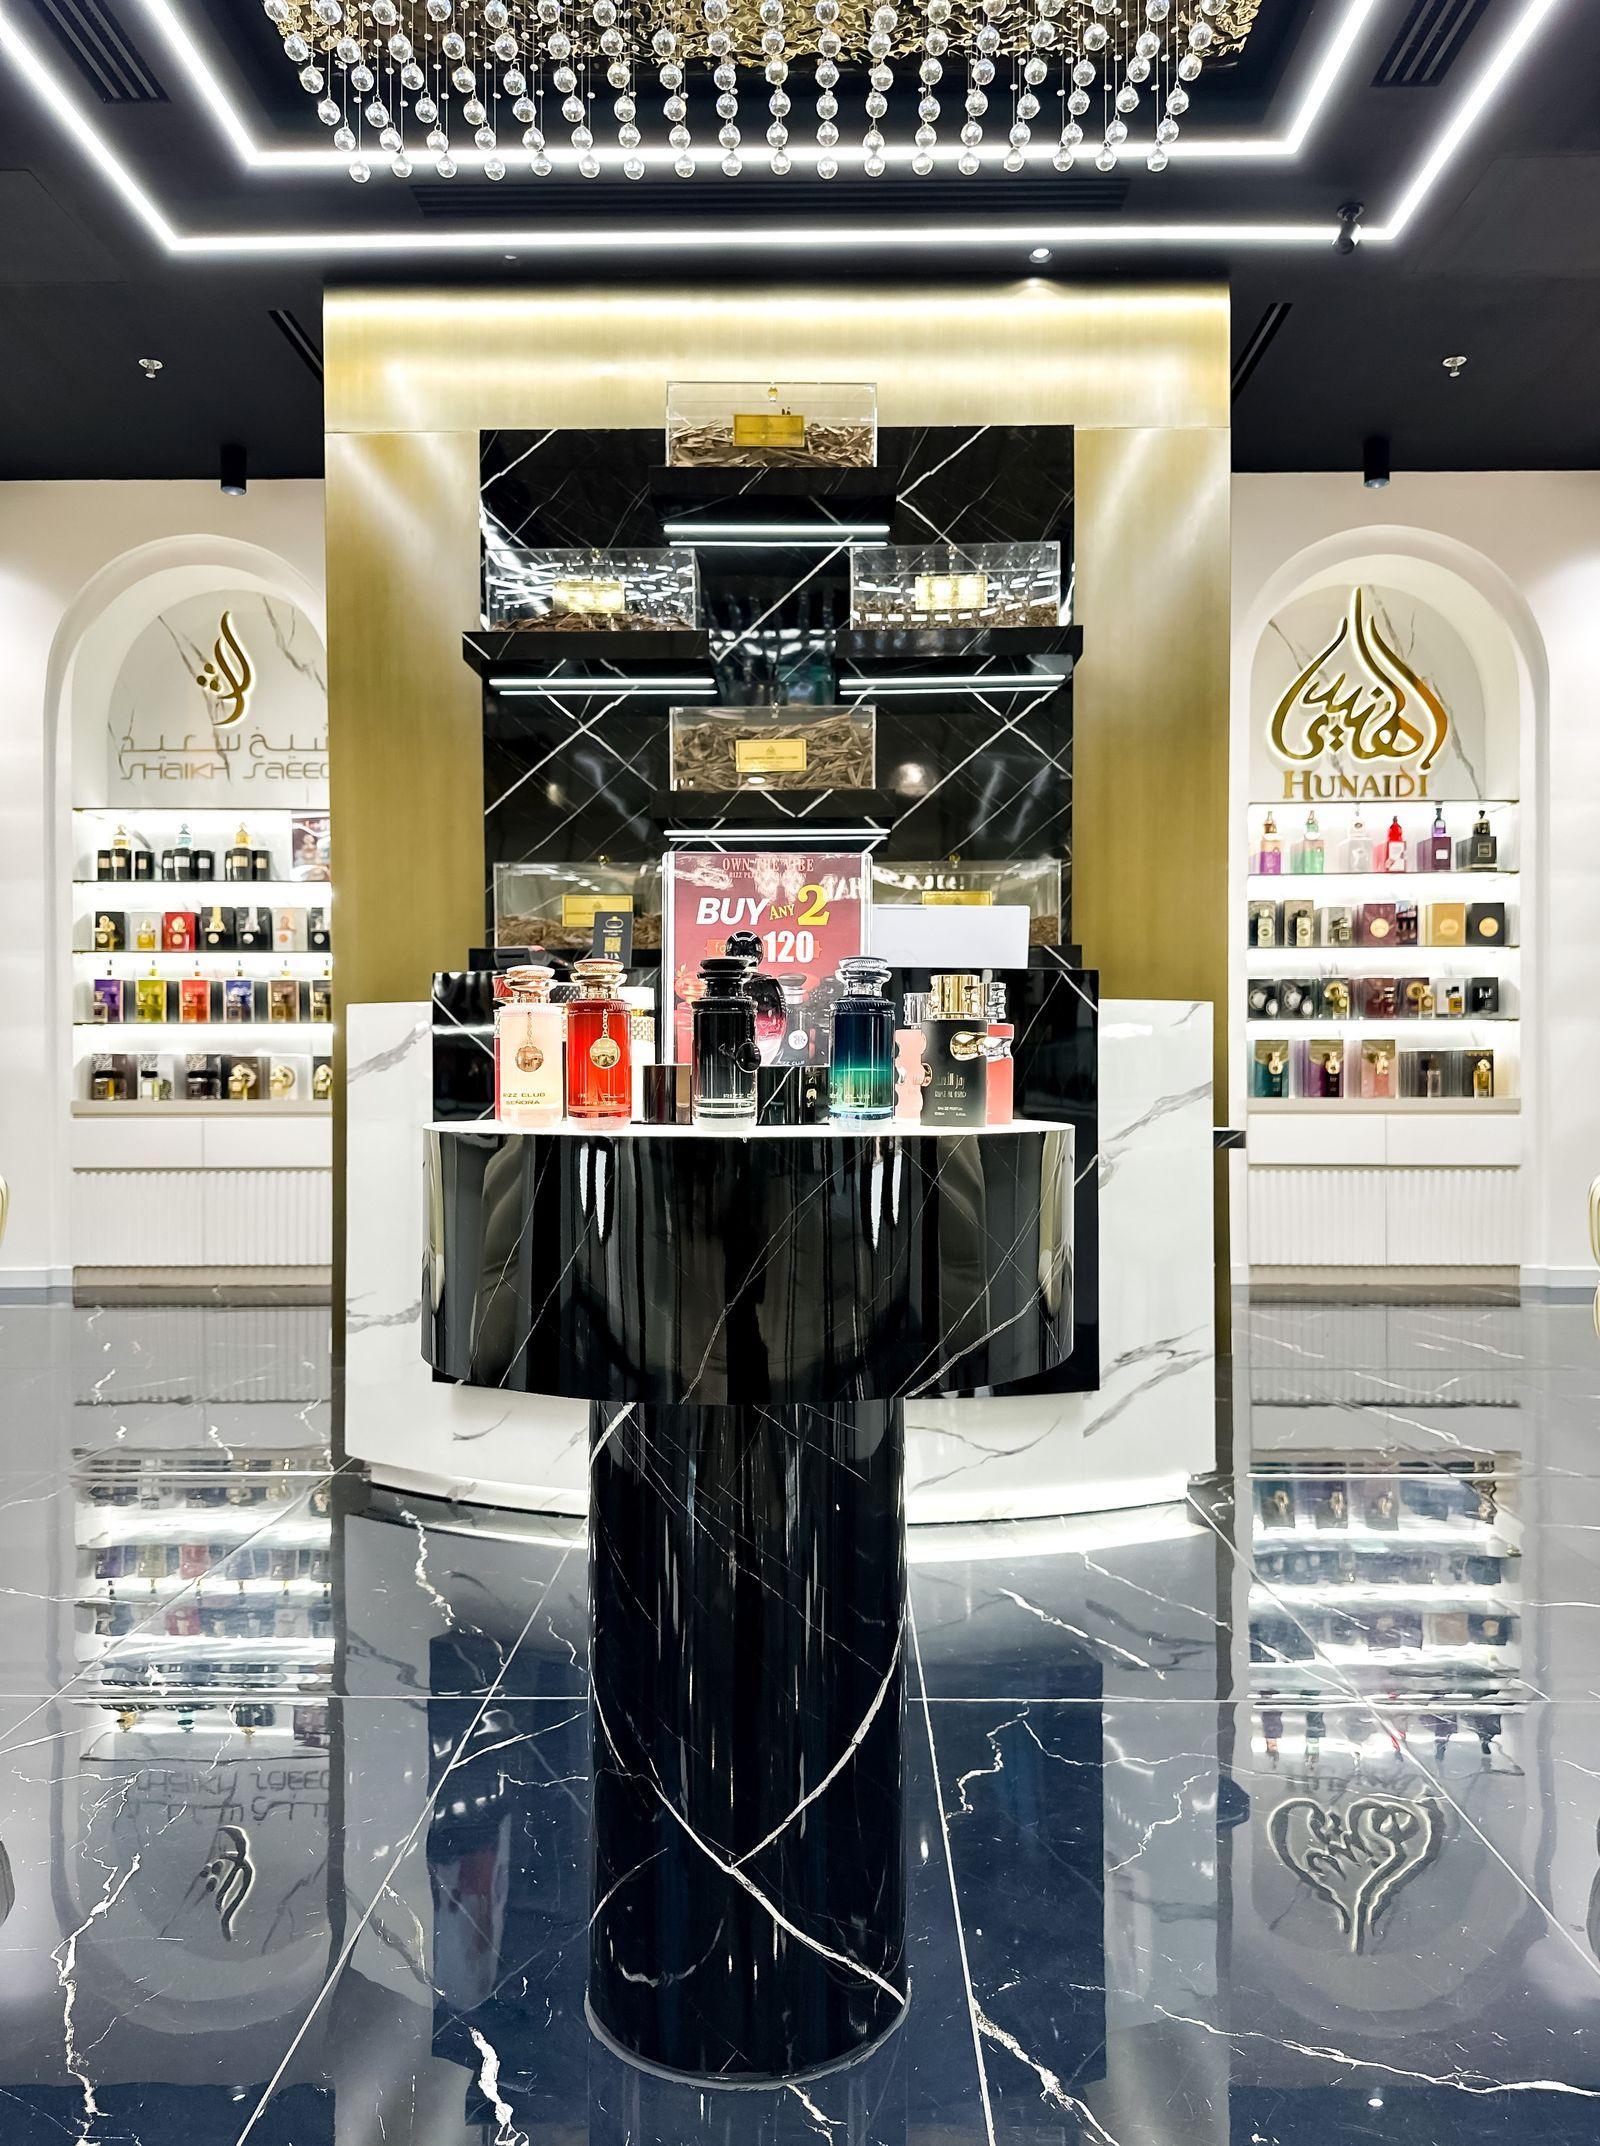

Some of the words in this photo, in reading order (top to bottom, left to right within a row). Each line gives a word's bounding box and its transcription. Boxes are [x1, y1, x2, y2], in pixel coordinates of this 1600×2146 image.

[722, 857, 751, 872] OWN
[754, 857, 780, 872] THE
[781, 858, 814, 872] VIBE
[695, 897, 770, 926] BUY
[769, 903, 796, 921] ANY
[797, 884, 831, 926] 2
[762, 930, 814, 963] 120
